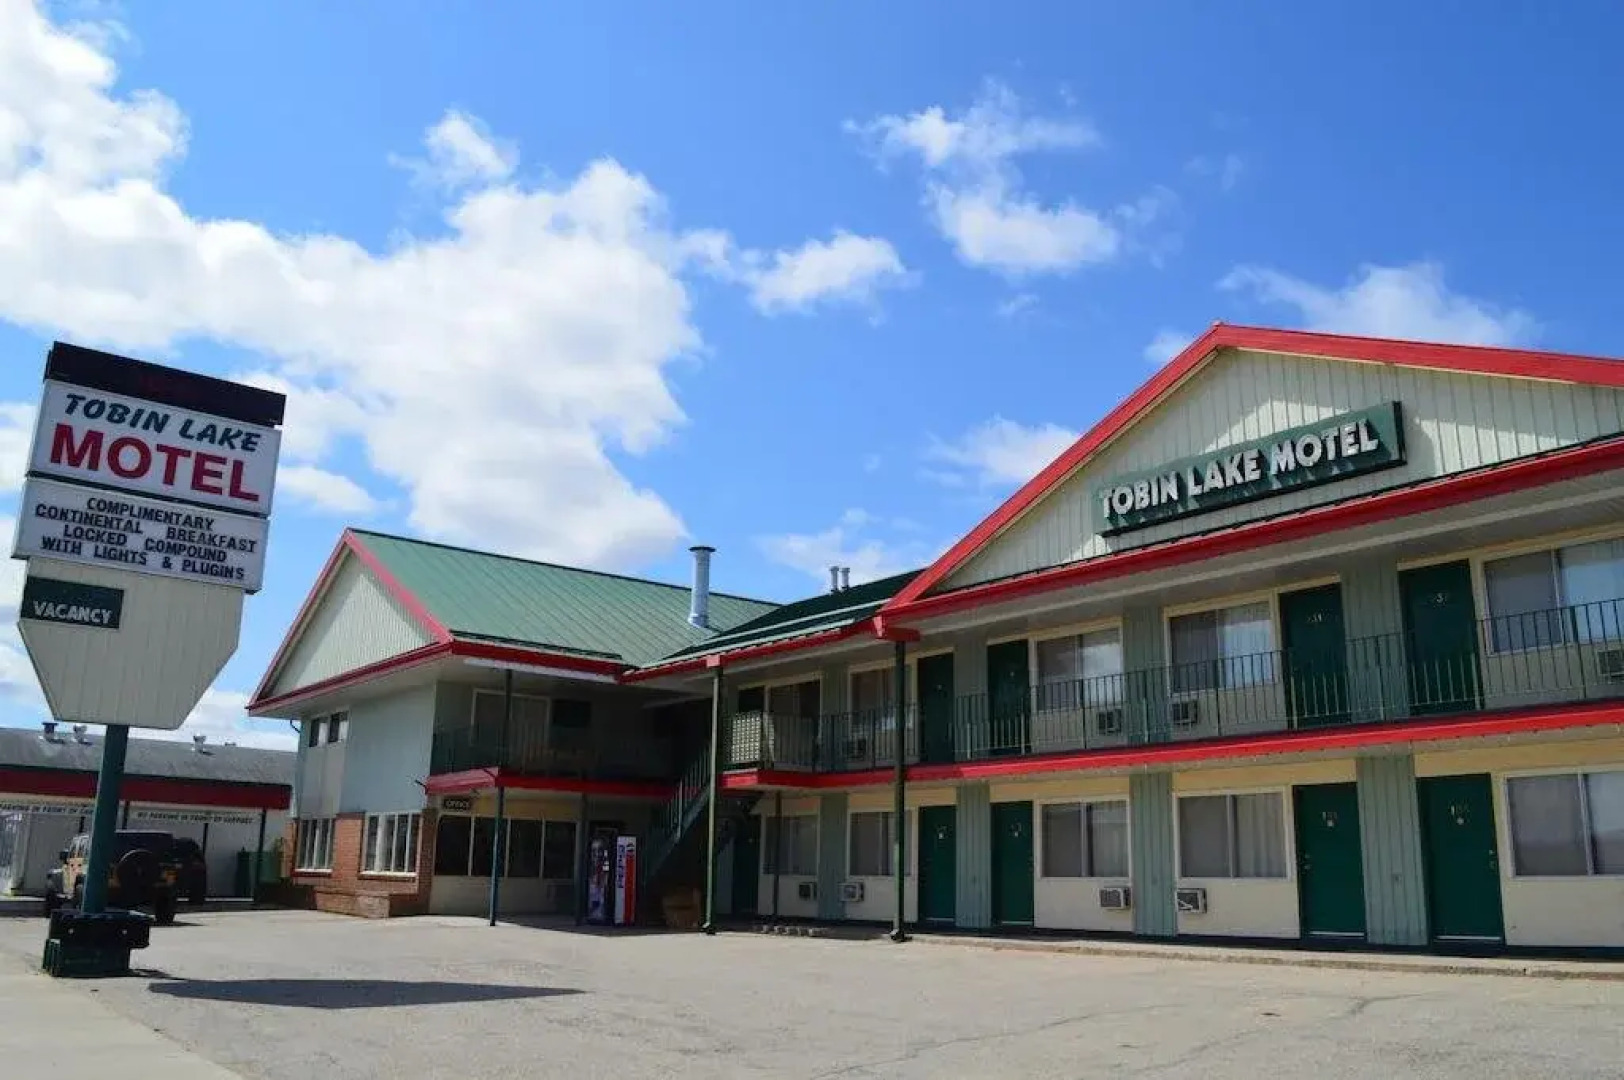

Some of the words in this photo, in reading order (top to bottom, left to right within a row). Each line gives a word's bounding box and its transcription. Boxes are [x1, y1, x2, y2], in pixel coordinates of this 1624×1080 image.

[66, 393, 170, 434] TOBIN
[178, 418, 261, 452] LAKE
[50, 422, 259, 502] MOTEL
[1102, 471, 1179, 518] TOBIN
[1187, 449, 1261, 496] LAKE
[1270, 418, 1379, 475] MOTEL
[35, 503, 143, 534] CONTINENTAL
[166, 527, 257, 553] BREAKFAST
[86, 497, 215, 531] COMPLIMENTARY
[41, 536, 83, 554] WITH
[93, 544, 147, 566] LIGHTS
[162, 558, 173, 570] &
[181, 559, 245, 580] PLUGINS
[63, 524, 128, 546] LOCKED
[144, 538, 227, 562] COMPOUND
[32, 600, 112, 624] VACANCY
